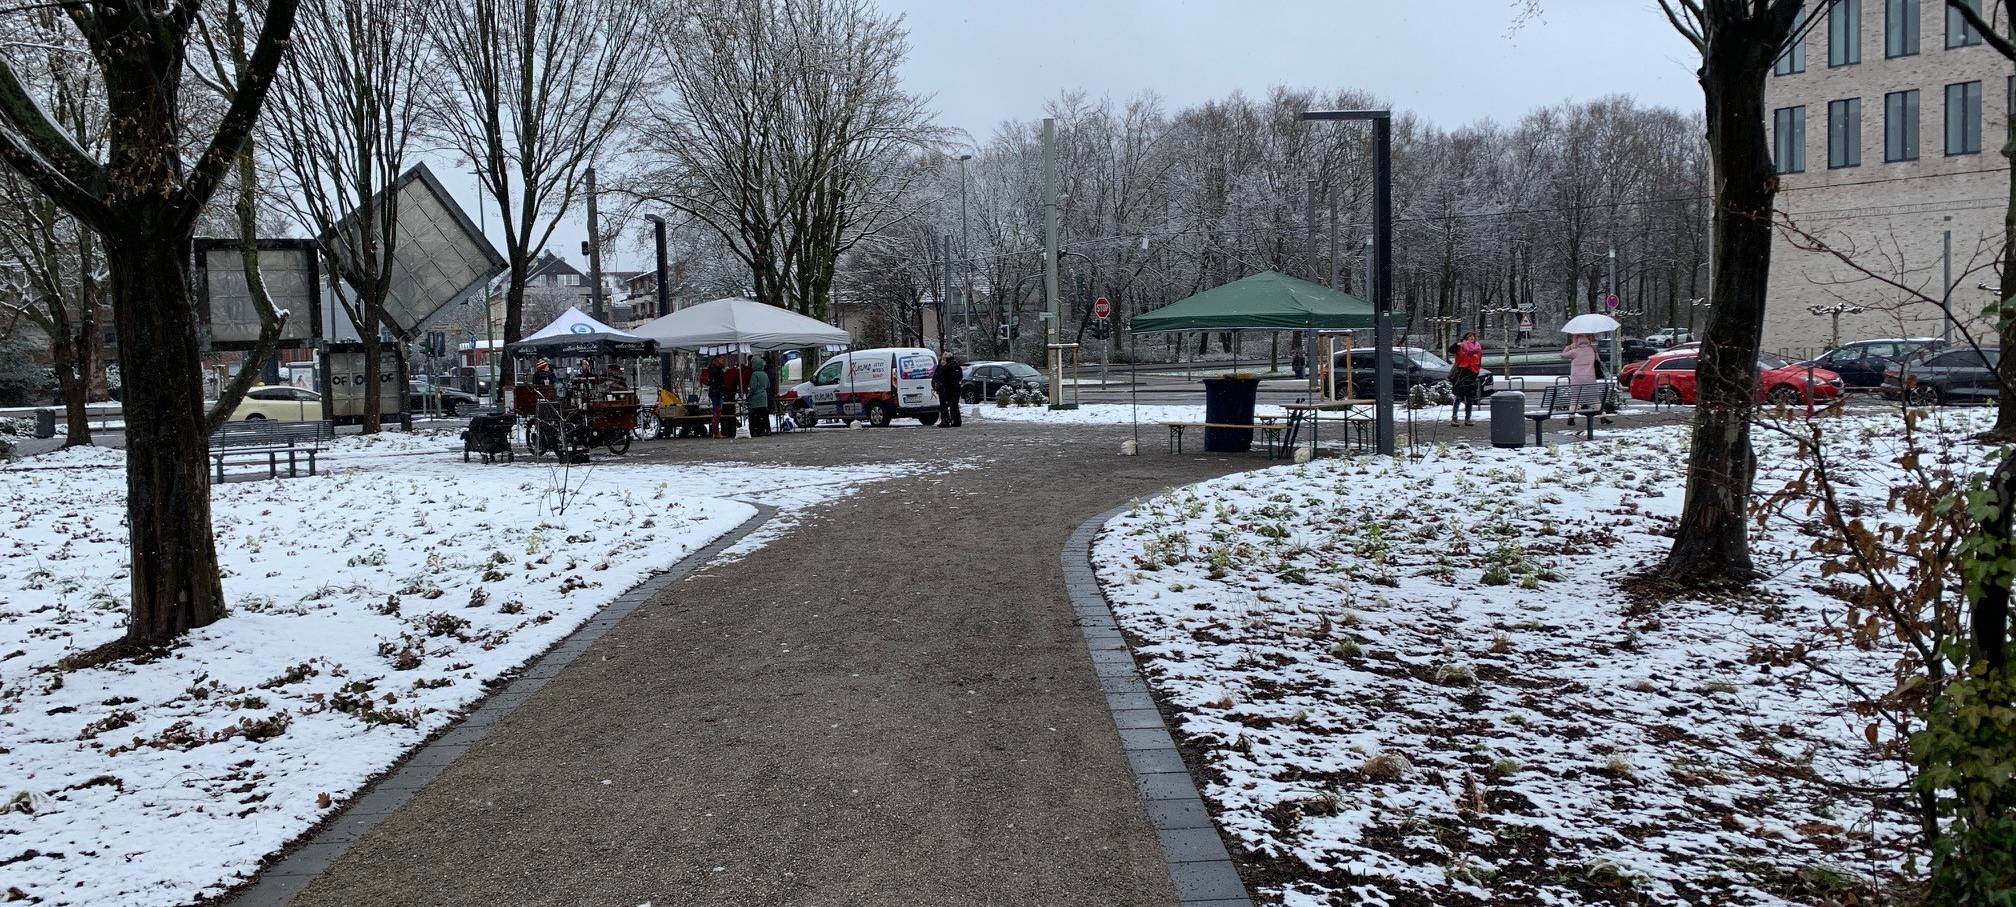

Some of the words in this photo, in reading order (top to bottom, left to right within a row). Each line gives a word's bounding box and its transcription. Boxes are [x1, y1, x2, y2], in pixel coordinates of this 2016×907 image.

[1097, 303, 1108, 312] STOP
[332, 376, 347, 385] OF
[381, 373, 394, 384] OF
